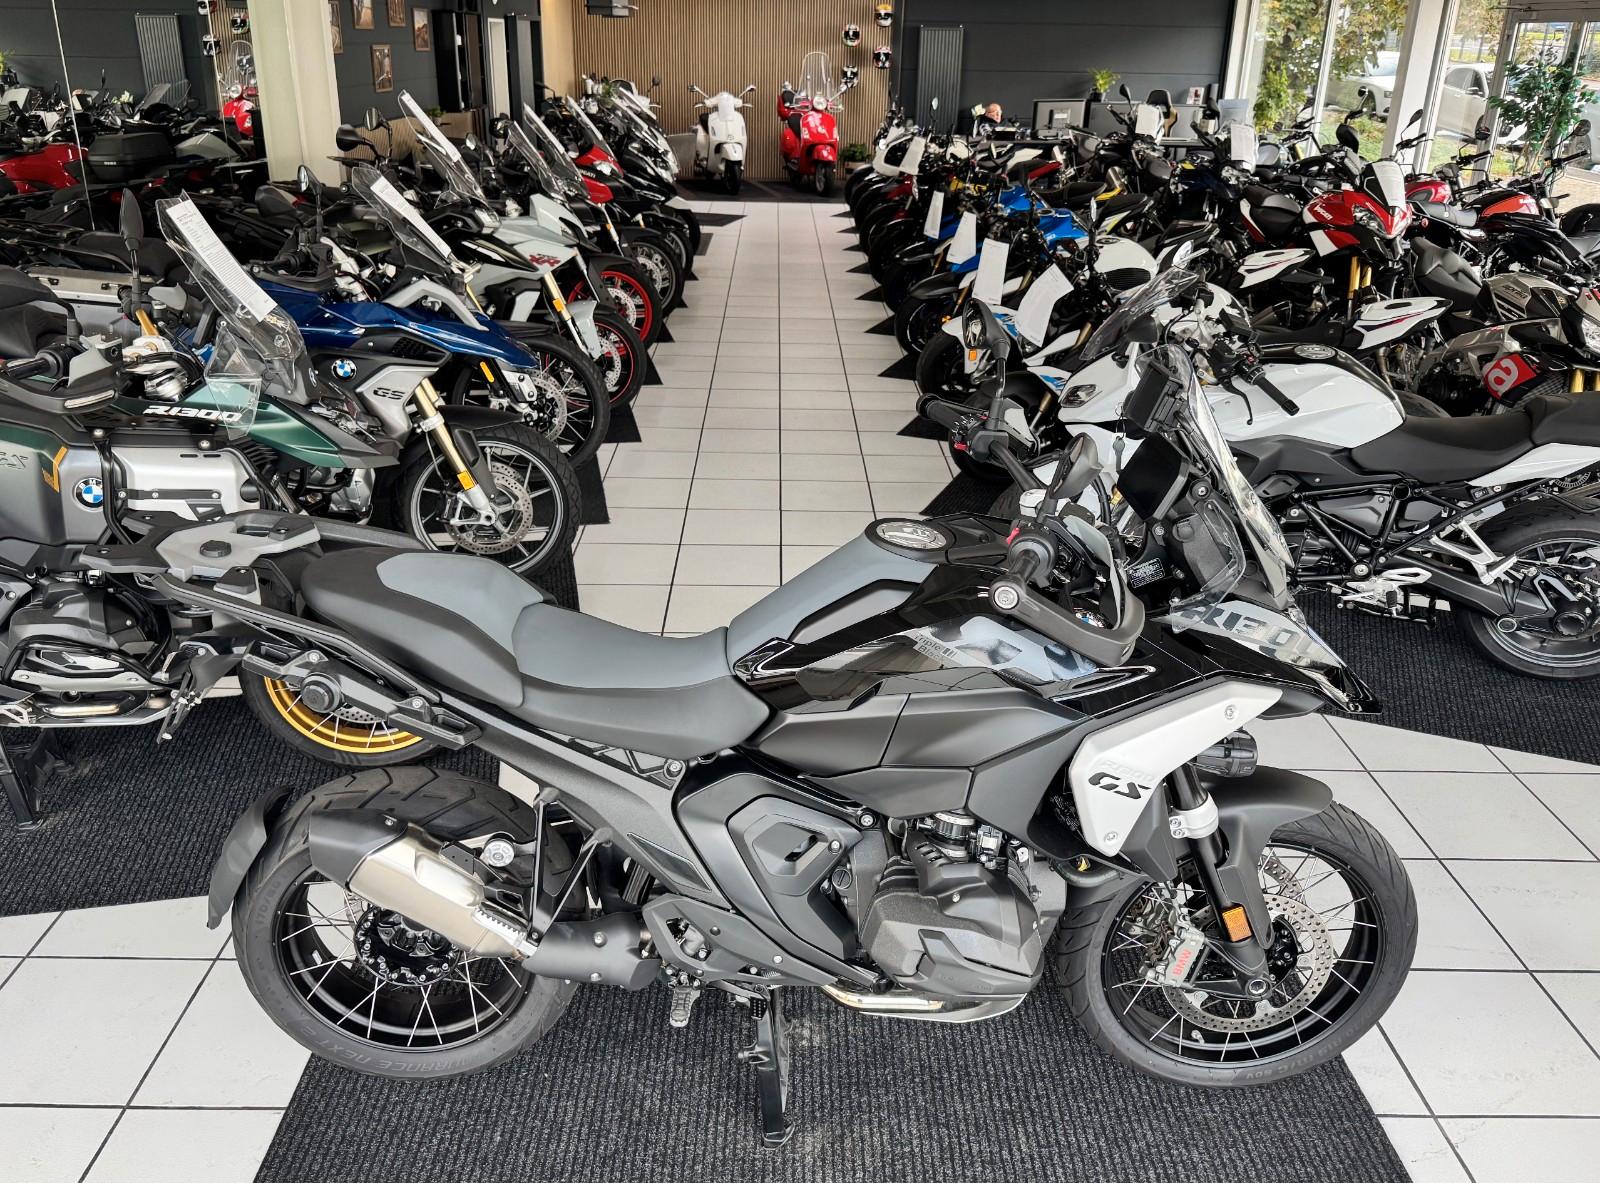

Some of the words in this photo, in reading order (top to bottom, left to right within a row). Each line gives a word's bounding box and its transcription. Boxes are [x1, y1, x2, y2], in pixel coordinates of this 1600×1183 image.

[372, 386, 406, 400] GS
[142, 404, 243, 423] R1300
[1088, 771, 1152, 800] GS
[1172, 948, 1192, 976] BMW
